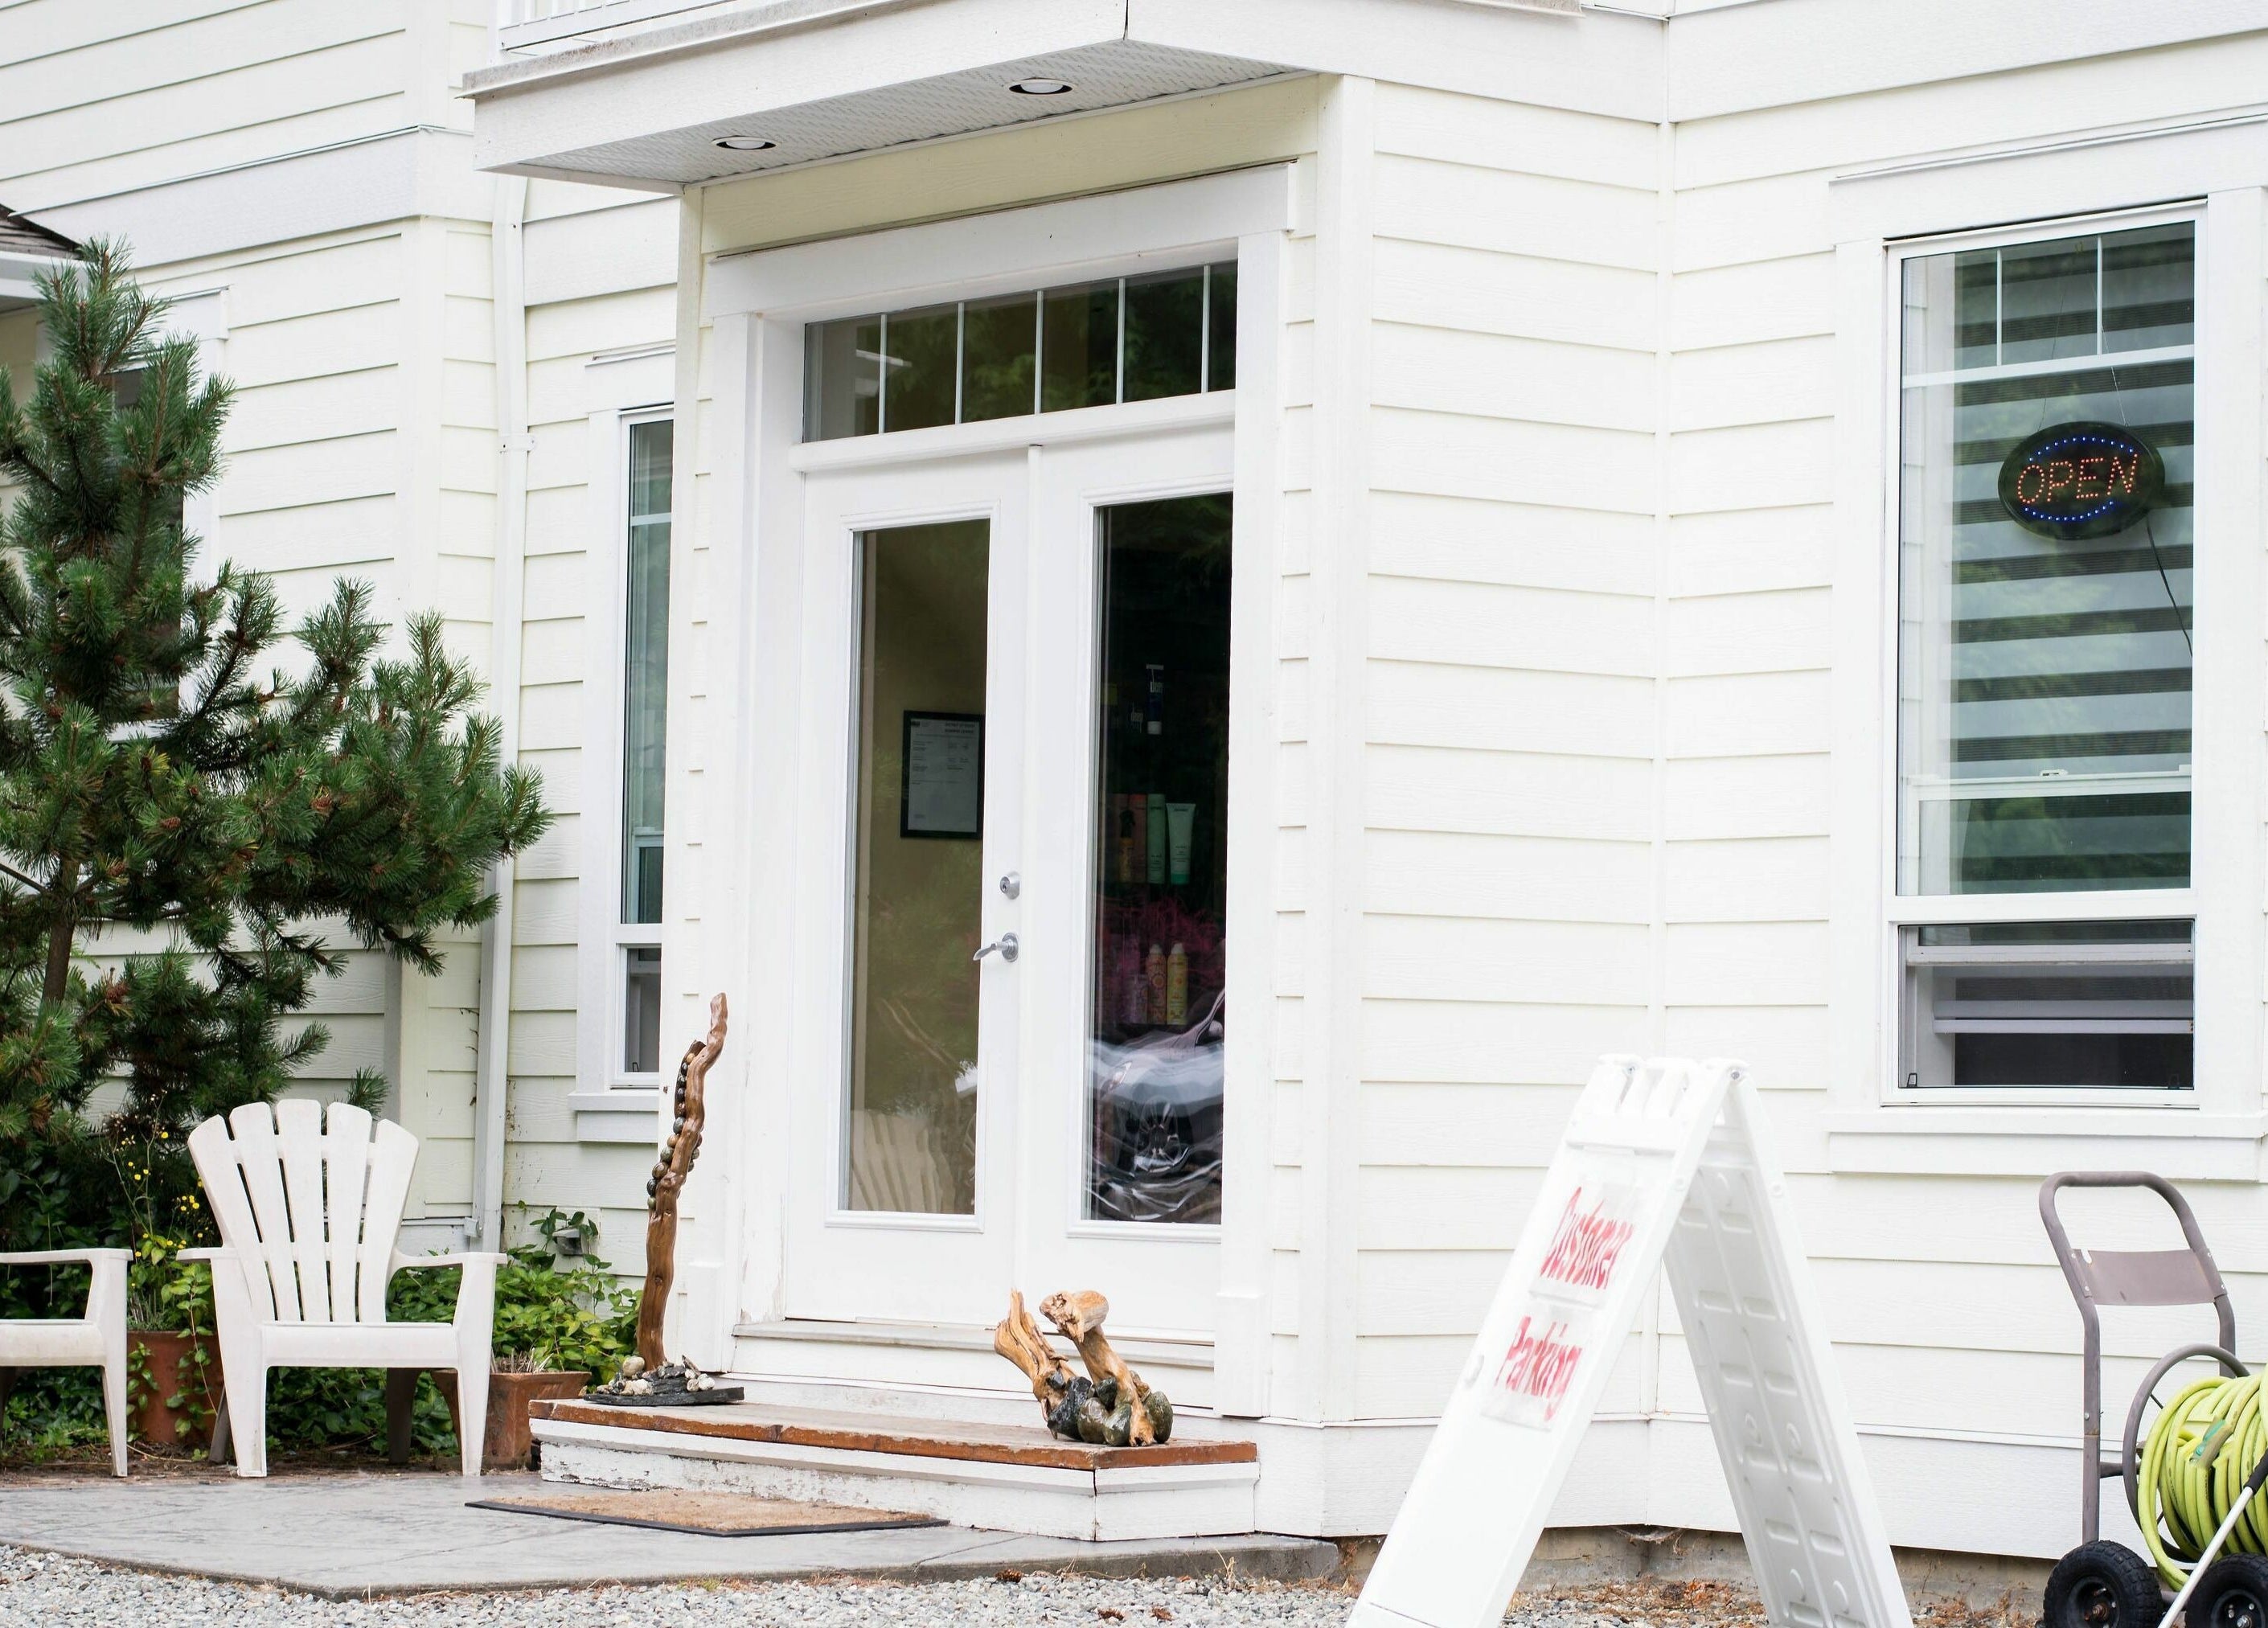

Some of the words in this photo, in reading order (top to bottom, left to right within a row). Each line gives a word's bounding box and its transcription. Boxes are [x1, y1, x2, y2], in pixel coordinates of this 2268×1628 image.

[2016, 453, 2139, 504] OPEN
[1539, 1186, 1634, 1290] Customer
[1495, 1315, 1583, 1421] Parking
